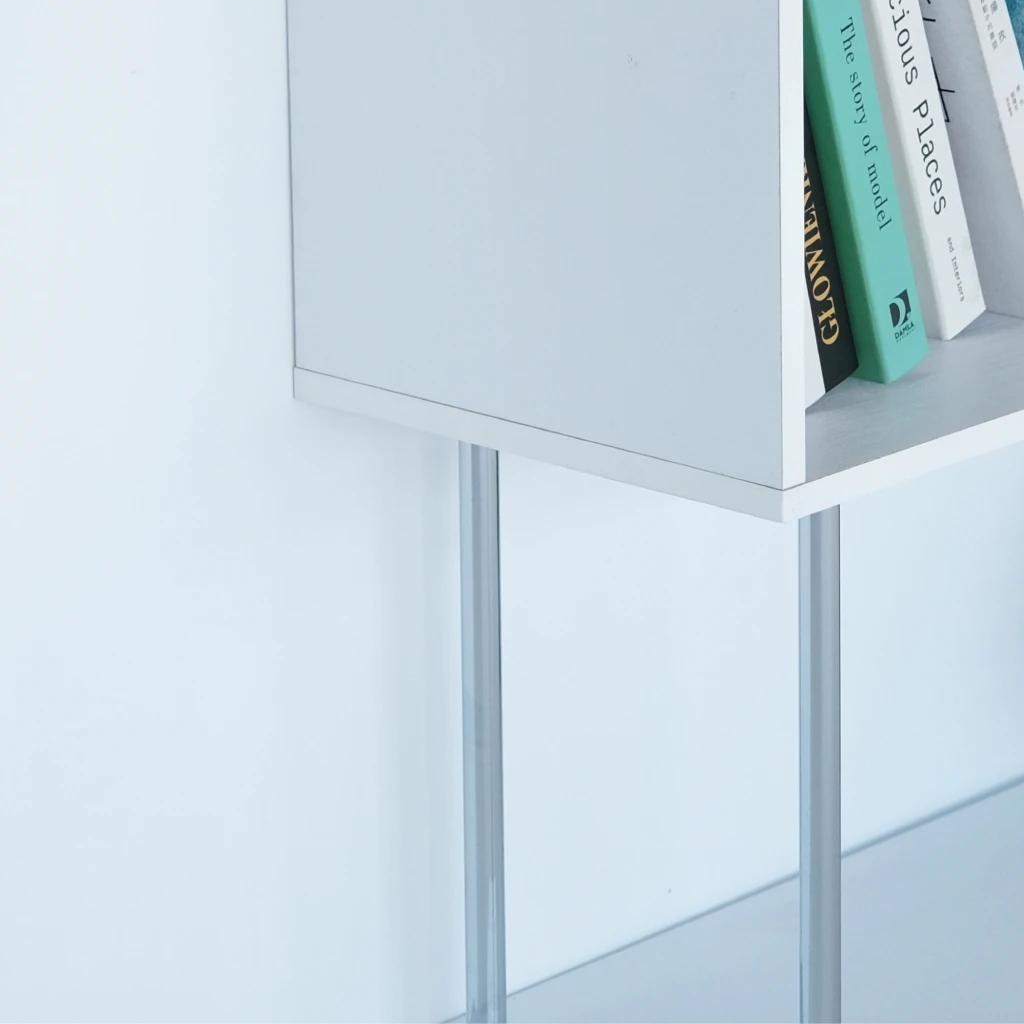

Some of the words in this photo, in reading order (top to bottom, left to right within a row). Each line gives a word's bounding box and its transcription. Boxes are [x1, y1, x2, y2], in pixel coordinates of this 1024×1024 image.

[840, 16, 857, 65] The
[849, 71, 868, 125] story
[861, 134, 879, 157] of
[912, 99, 947, 215] Places
[867, 163, 893, 232] model
[803, 158, 840, 345] GŁOWIEN
[946, 236, 955, 253] and
[951, 256, 965, 303] Interiors
[894, 321, 915, 340] DAMLA
